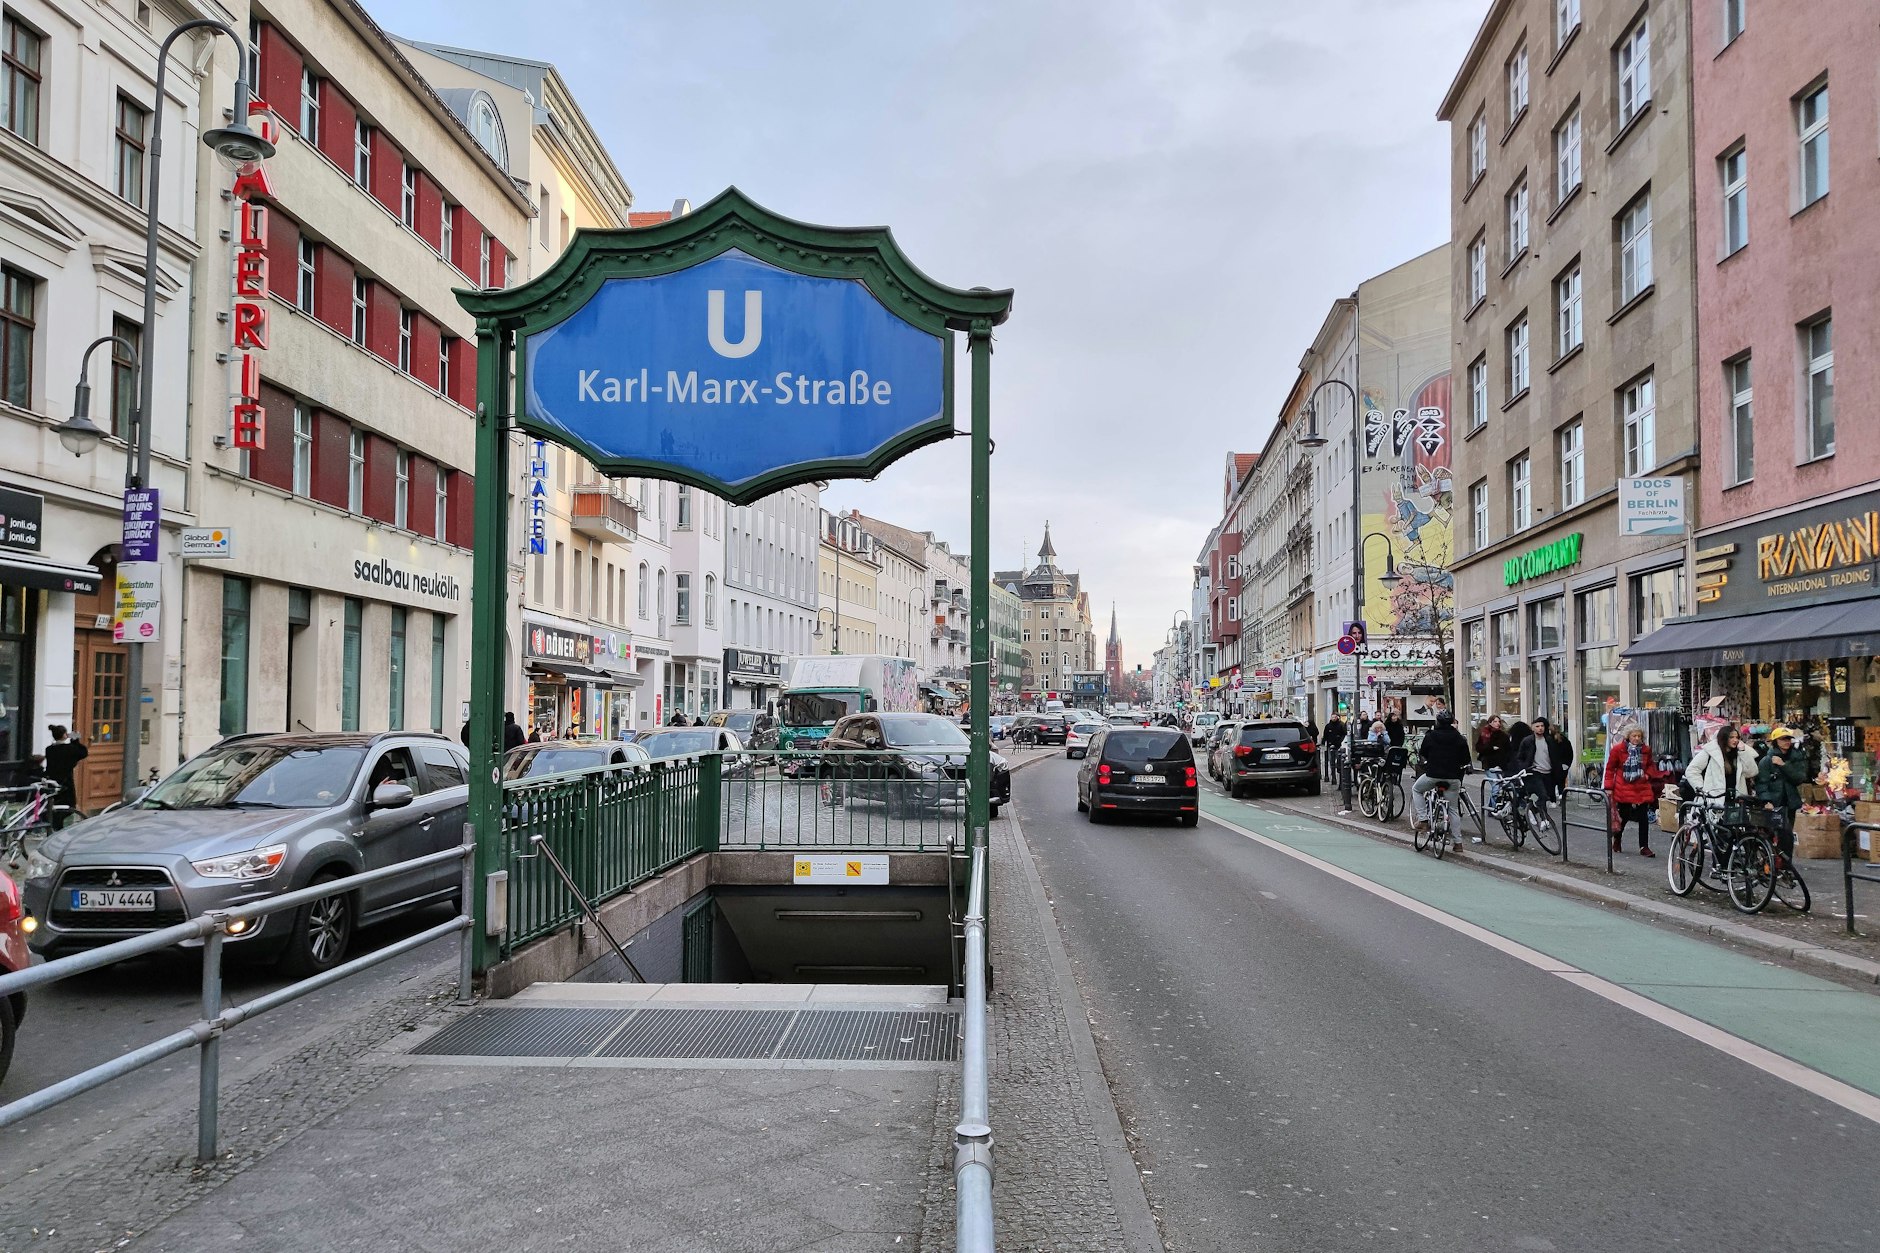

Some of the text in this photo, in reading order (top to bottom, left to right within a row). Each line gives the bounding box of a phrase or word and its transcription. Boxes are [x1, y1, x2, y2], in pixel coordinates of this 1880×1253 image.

[707, 289, 763, 359] U
[578, 368, 892, 405] Karl-Marx-Straße
[1633, 479, 1672, 489] DOCS
[127, 493, 150, 502] HOLEN
[1627, 499, 1678, 509] BERLIN
[136, 502, 153, 511] UNS
[130, 512, 143, 520] DIE
[10, 518, 37, 532] jonti.de
[124, 521, 155, 530] ZUKUNFT
[8, 531, 36, 545] jonti.de
[1757, 510, 1879, 581] RAYAN
[1504, 532, 1582, 586] BIO COMPANY
[354, 558, 459, 601] saalbau neukölln
[1767, 569, 1870, 597] INTERNATIONAL TRADING
[546, 632, 574, 658] DÖNER
[1354, 642, 1368, 654] olt
[1362, 648, 1442, 661] OTO FLAS
[1722, 650, 1744, 660] RAYAN
[80, 892, 153, 906] B JV 4444
